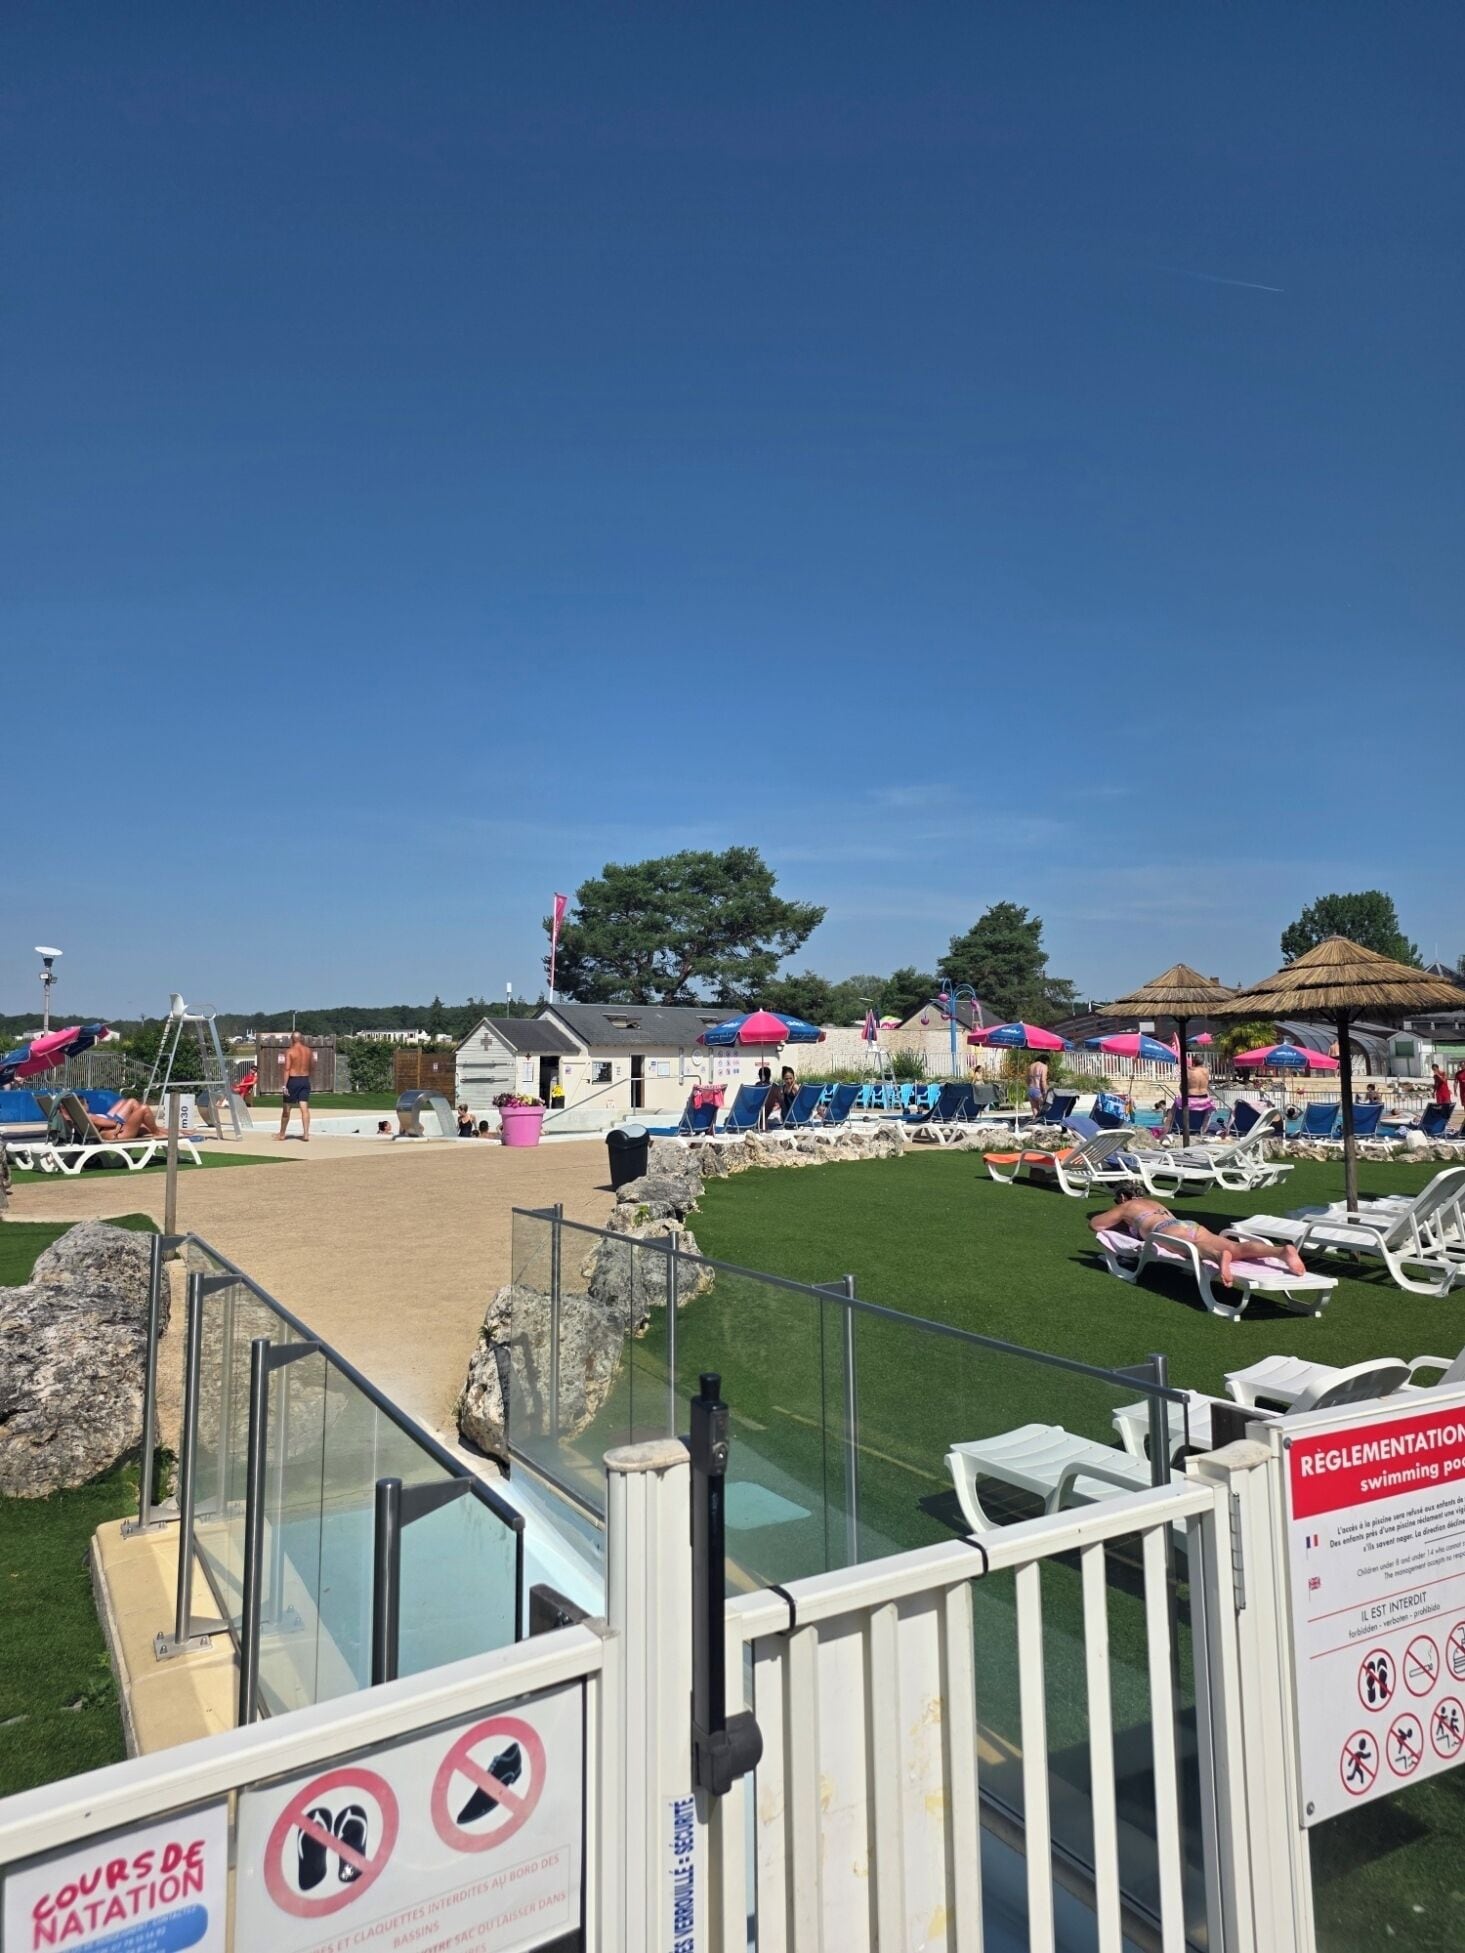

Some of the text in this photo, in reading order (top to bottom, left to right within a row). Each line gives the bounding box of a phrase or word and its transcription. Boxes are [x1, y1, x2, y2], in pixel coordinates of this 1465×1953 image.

[1360, 1463, 1439, 1492] swimming
[1372, 1516, 1392, 1527] piscine
[1436, 1498, 1456, 1510] enfants
[1329, 1540, 1341, 1548] Des
[1342, 1533, 1364, 1545] enfants
[1379, 1525, 1396, 1535] d'une
[1396, 1520, 1416, 1531] piscine
[1376, 1537, 1395, 1548] savent
[1414, 1529, 1421, 1538] La
[1422, 1523, 1446, 1536] direction
[1357, 1566, 1379, 1577] Children
[1379, 1561, 1394, 1570] under
[1394, 1562, 1426, 1576] management
[1349, 1624, 1378, 1639] forbidden
[1383, 1613, 1409, 1627] verboten
[1413, 1603, 1441, 1619] prohibido
[1361, 1591, 1427, 1622] IL EST INTERDIT
[669, 1797, 694, 1856] SÉCURITÉ
[32, 1840, 206, 1920] COURS DE
[32, 1864, 204, 1951] NATATION
[336, 1936, 350, 1952] ET
[353, 1908, 425, 1944] CLAQUETTES
[427, 1881, 489, 1915] INTERDITES
[491, 1876, 506, 1890] AU
[509, 1862, 538, 1882] BORD
[541, 1853, 560, 1869] DES
[669, 1864, 694, 1940] VERROUILLÉ
[453, 1928, 476, 1946] SAC
[477, 1920, 494, 1935] OU
[496, 1900, 536, 1927] LAISSER
[538, 1891, 566, 1912] DANS
[393, 1920, 440, 1949] BASSINS
